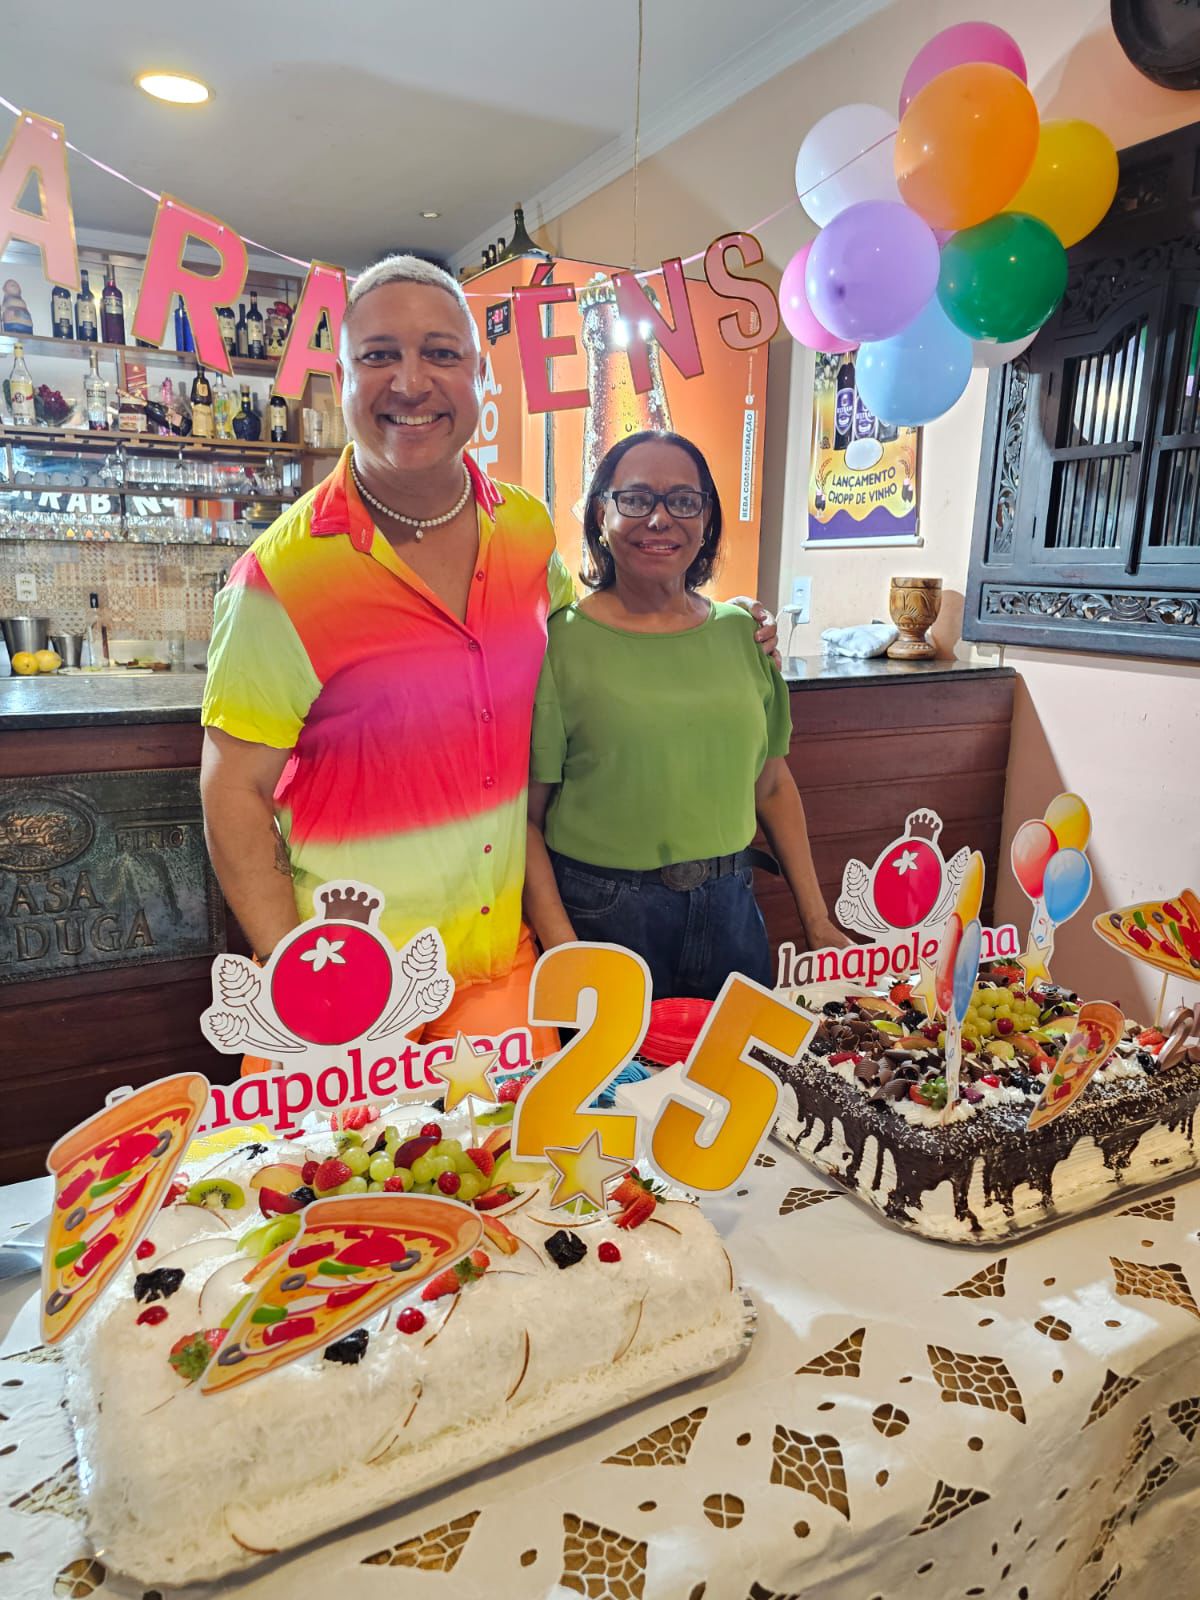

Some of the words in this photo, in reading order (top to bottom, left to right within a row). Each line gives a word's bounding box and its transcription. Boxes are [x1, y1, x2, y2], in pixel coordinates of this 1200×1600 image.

[828, 490, 854, 505] CHOPP
[856, 491, 866, 504] DE
[870, 483, 898, 502] VINHO
[832, 466, 896, 491] LANÇAMENTO
[0, 870, 105, 918] ASA
[0, 909, 158, 965] DUGA
[779, 927, 1018, 989] lanapolena
